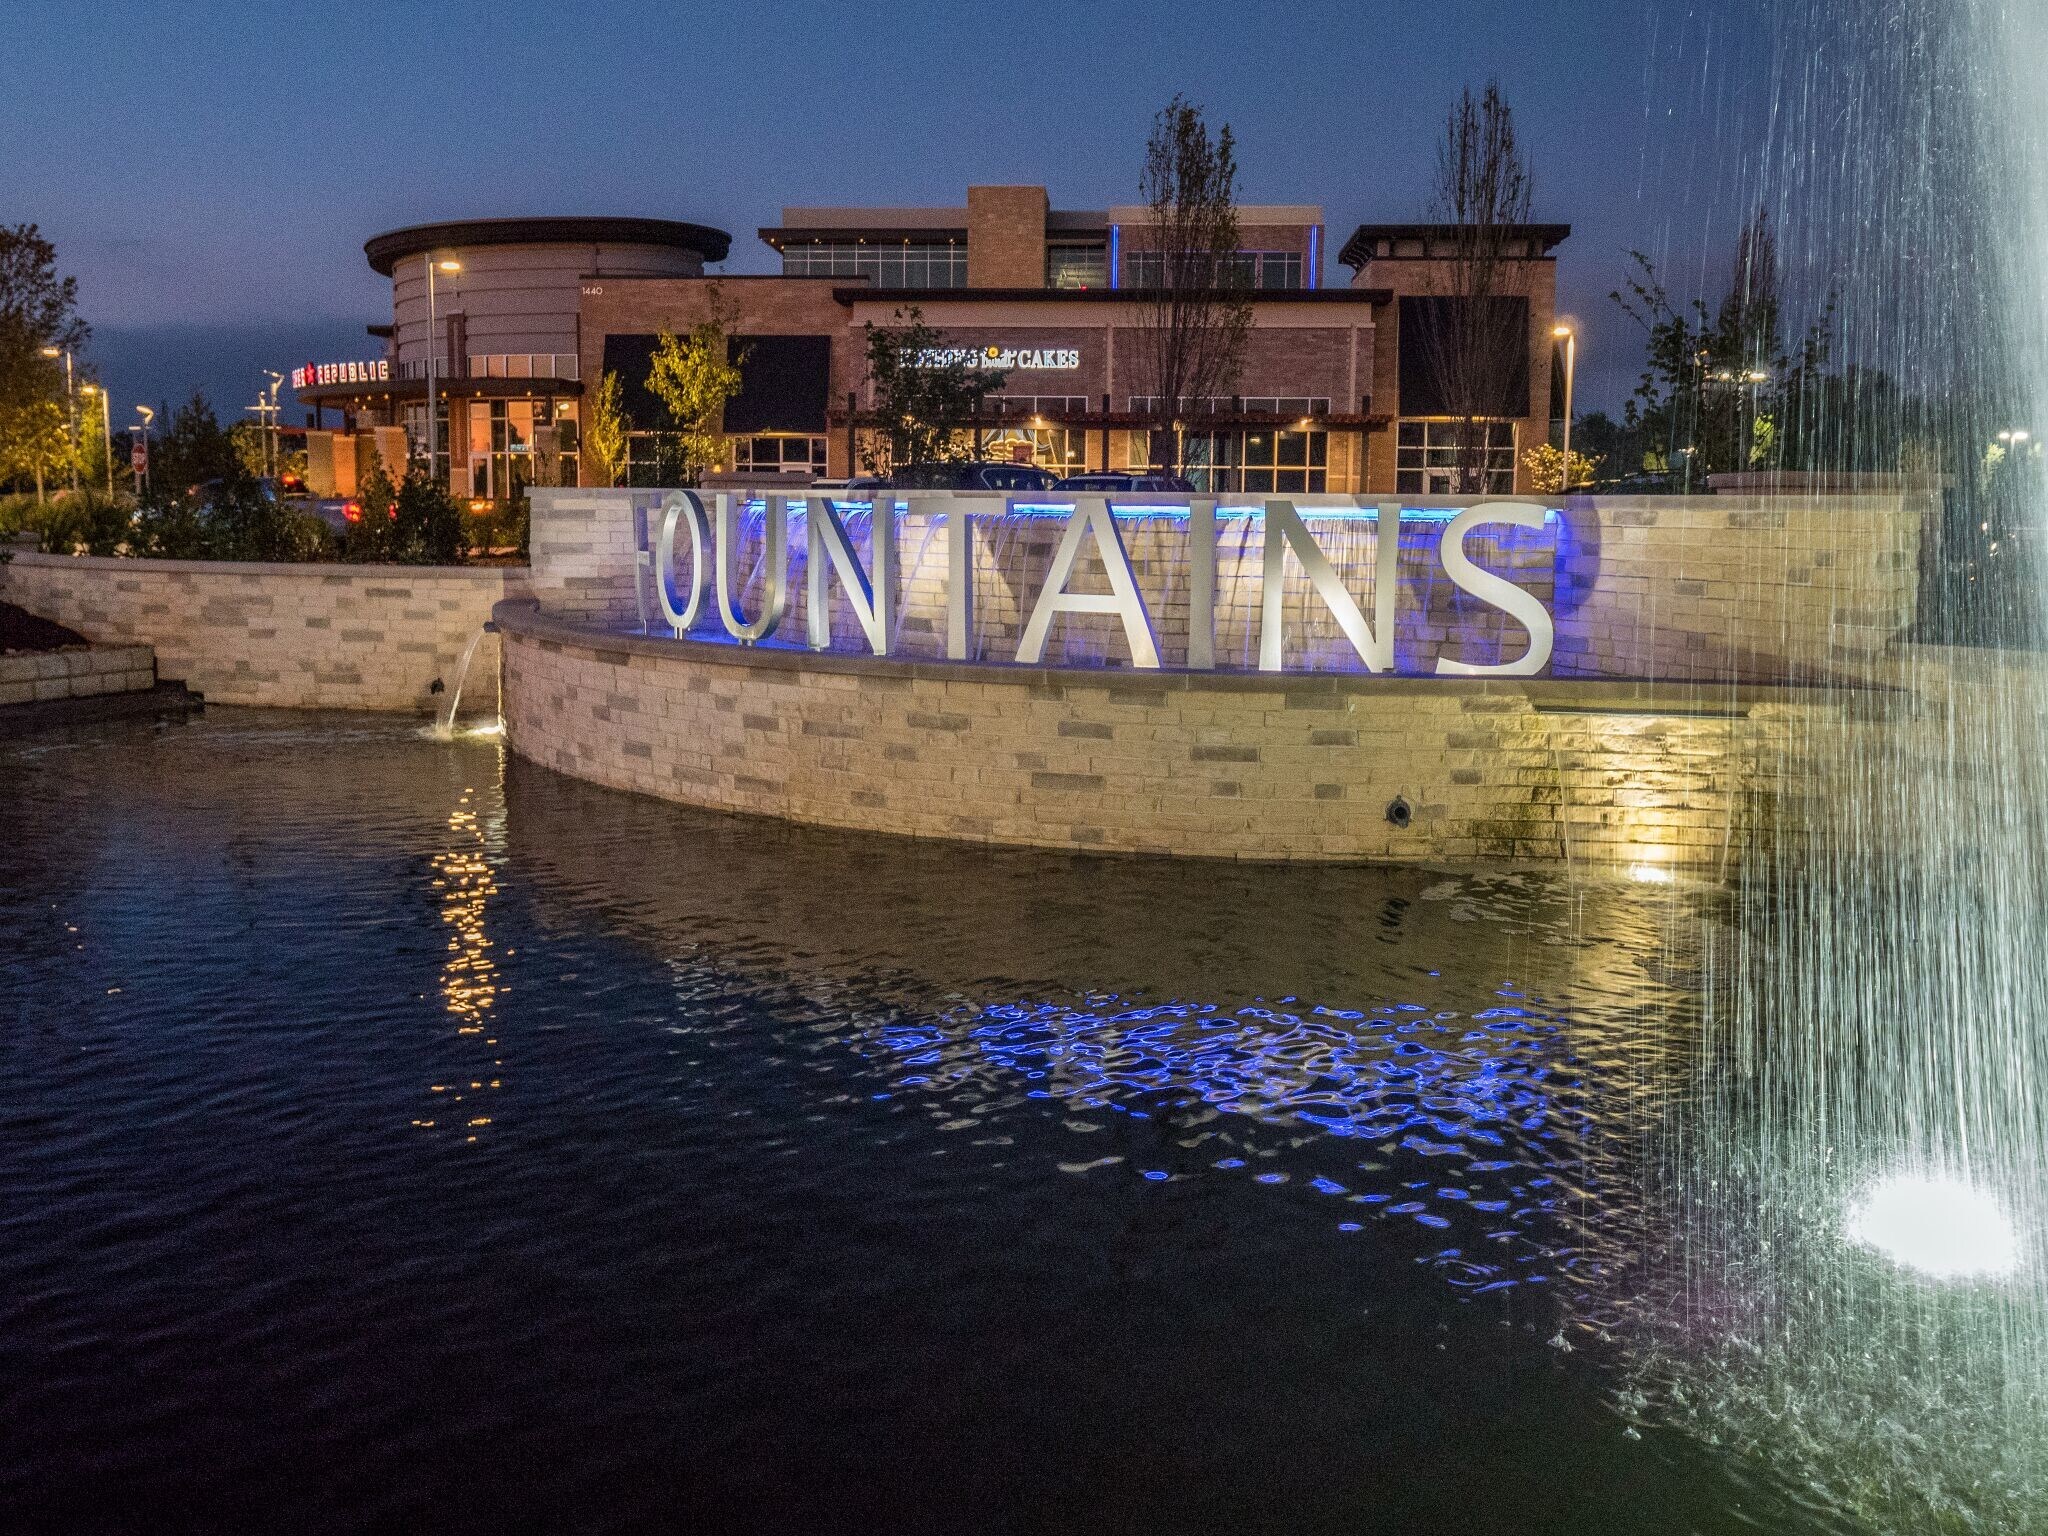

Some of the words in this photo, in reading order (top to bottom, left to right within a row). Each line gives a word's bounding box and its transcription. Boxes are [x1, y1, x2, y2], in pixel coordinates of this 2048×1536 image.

[582, 287, 603, 295] 1440
[1018, 349, 1079, 369] CAKES
[317, 360, 389, 386] REPUBLIC
[632, 490, 1554, 677] FOUNTAINS
